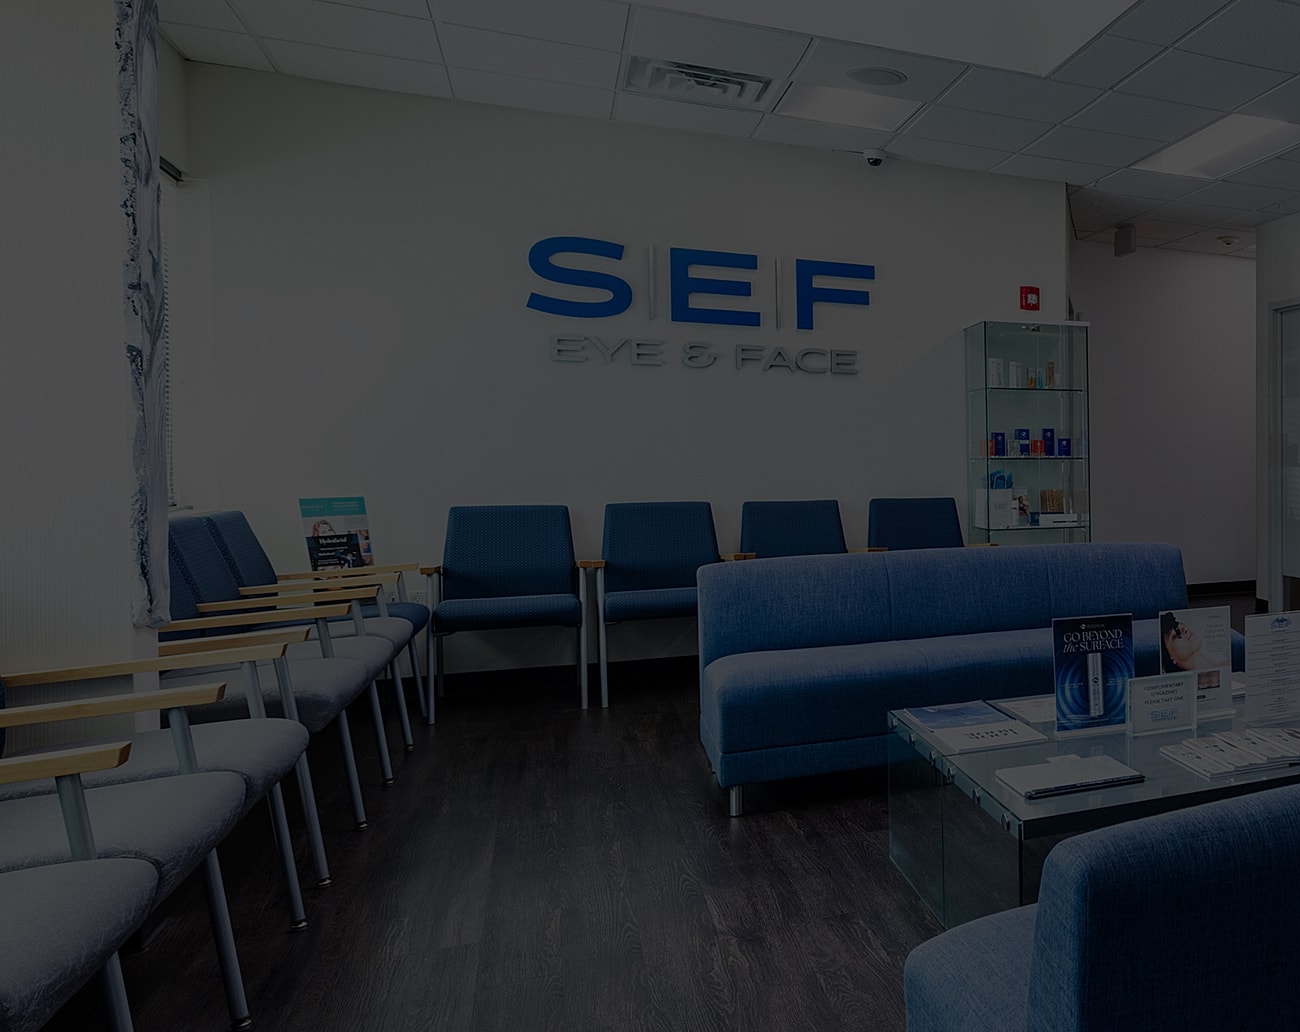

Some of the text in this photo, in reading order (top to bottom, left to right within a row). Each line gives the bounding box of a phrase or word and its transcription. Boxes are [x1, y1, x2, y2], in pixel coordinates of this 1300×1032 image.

[550, 333, 859, 376] EYE & FACE
[1063, 628, 1123, 643] GO BEYOND
[1063, 638, 1125, 653] the SURFACE
